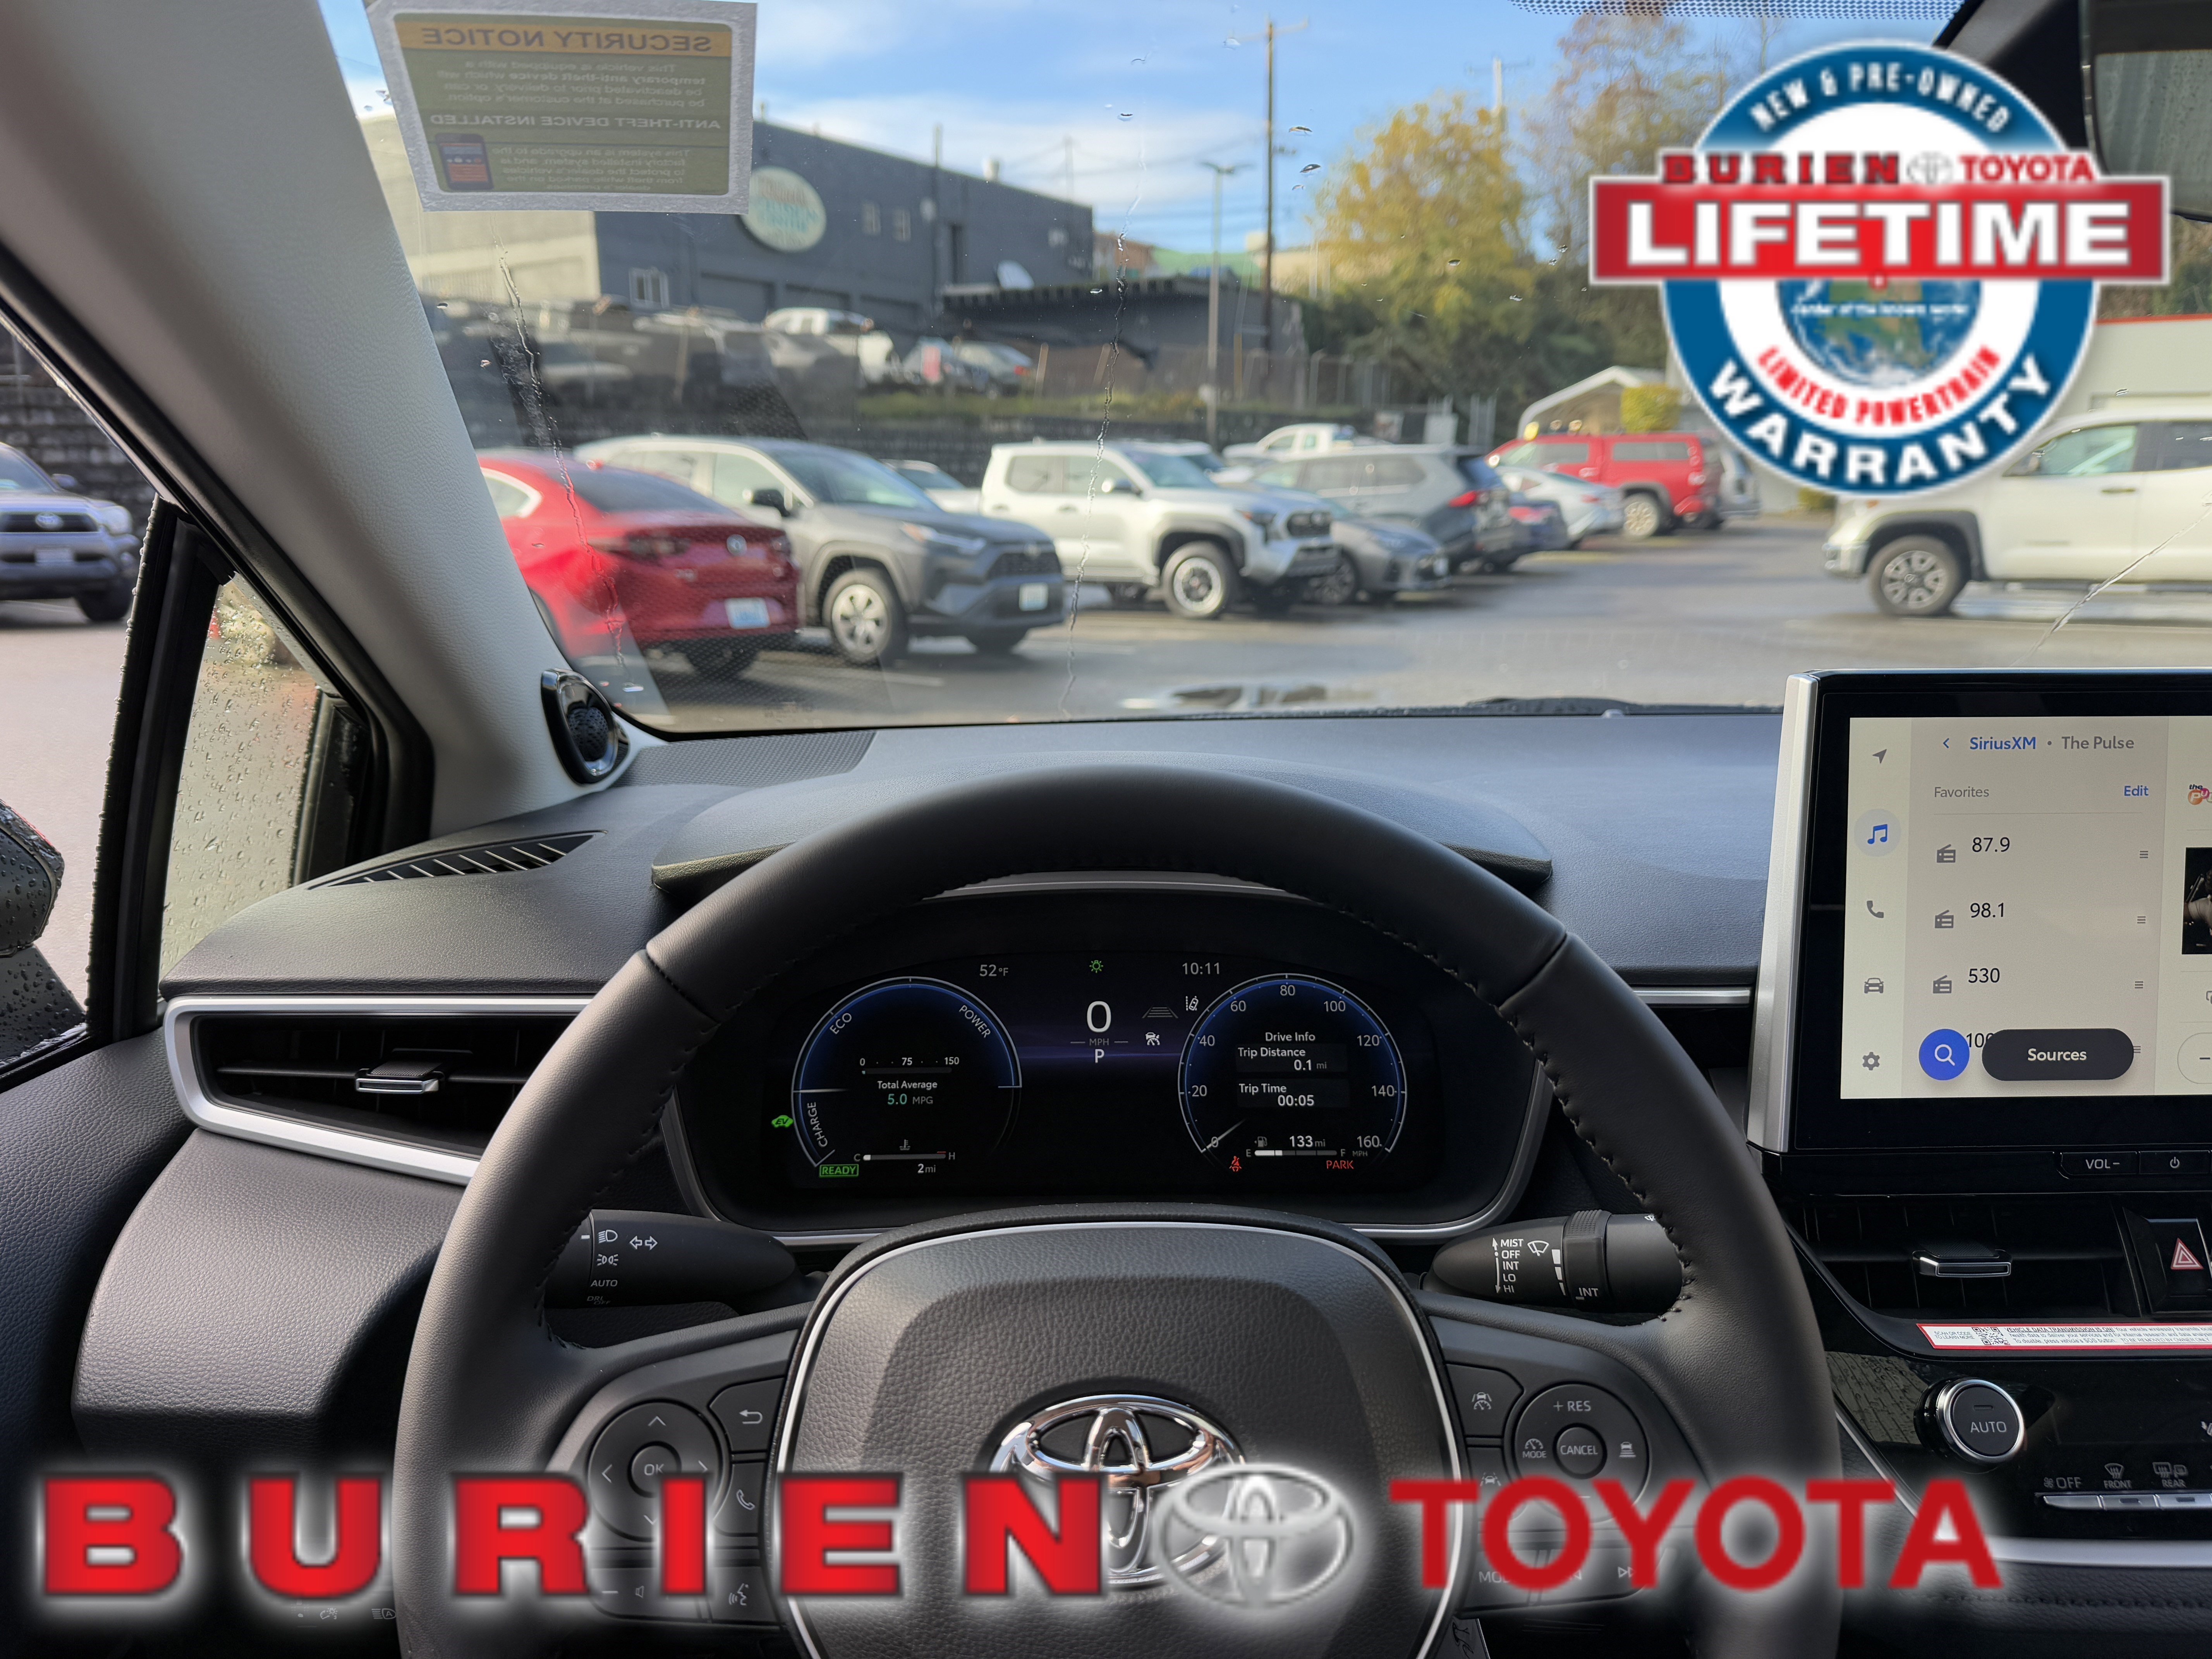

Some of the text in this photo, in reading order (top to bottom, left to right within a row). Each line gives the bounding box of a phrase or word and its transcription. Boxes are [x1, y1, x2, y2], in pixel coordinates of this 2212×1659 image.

[1970, 736, 2134, 749] SiriusXM The Pulse
[1935, 785, 2148, 797] Favorites Edit
[1973, 837, 2009, 852] 87.9
[1970, 903, 2003, 917] 98.1
[1183, 963, 1219, 974] 10:11
[1968, 968, 1999, 983] 530
[1280, 985, 1295, 996] 80
[1231, 1000, 1246, 1012] 60
[1324, 1000, 1345, 1012] 100
[959, 1005, 991, 1038] POWER
[1087, 1001, 1111, 1032] 0
[830, 1013, 852, 1034] ECO
[1199, 1035, 1215, 1046] 40
[1266, 1032, 1315, 1041] Drive Info
[1357, 1035, 1379, 1046] 120
[1095, 1049, 1104, 1063] P
[1238, 1048, 1305, 1058] Trip Distance
[2027, 1048, 2087, 1062] Sources
[1294, 1060, 1311, 1070] 0.1
[901, 1080, 938, 1090] Average
[1192, 1085, 1207, 1096] 20
[1240, 1084, 1286, 1094] Trip Time
[1371, 1085, 1394, 1096] 140
[888, 1094, 907, 1105] 5.0
[1278, 1095, 1314, 1106] 00:05
[807, 1102, 827, 1147] CHARGE
[1357, 1135, 1380, 1147] 160
[949, 1152, 955, 1160] H
[1326, 1160, 1354, 1169] PARK
[822, 1166, 856, 1175] READY
[1501, 1239, 1523, 1247] MIST
[1502, 1250, 1520, 1259] OFF
[1503, 1261, 1519, 1270] INT
[1503, 1274, 1516, 1282] LO
[1578, 1288, 1598, 1297] INT
[1568, 1401, 1591, 1411] RES
[1971, 1422, 2006, 1432] AUTO
[1560, 1445, 1598, 1455] CANCEL
[644, 1464, 664, 1475] OK
[2057, 1477, 2082, 1489] OFF
[2104, 1480, 2132, 1489] FRONT
[2162, 1479, 2187, 1488] REAR
